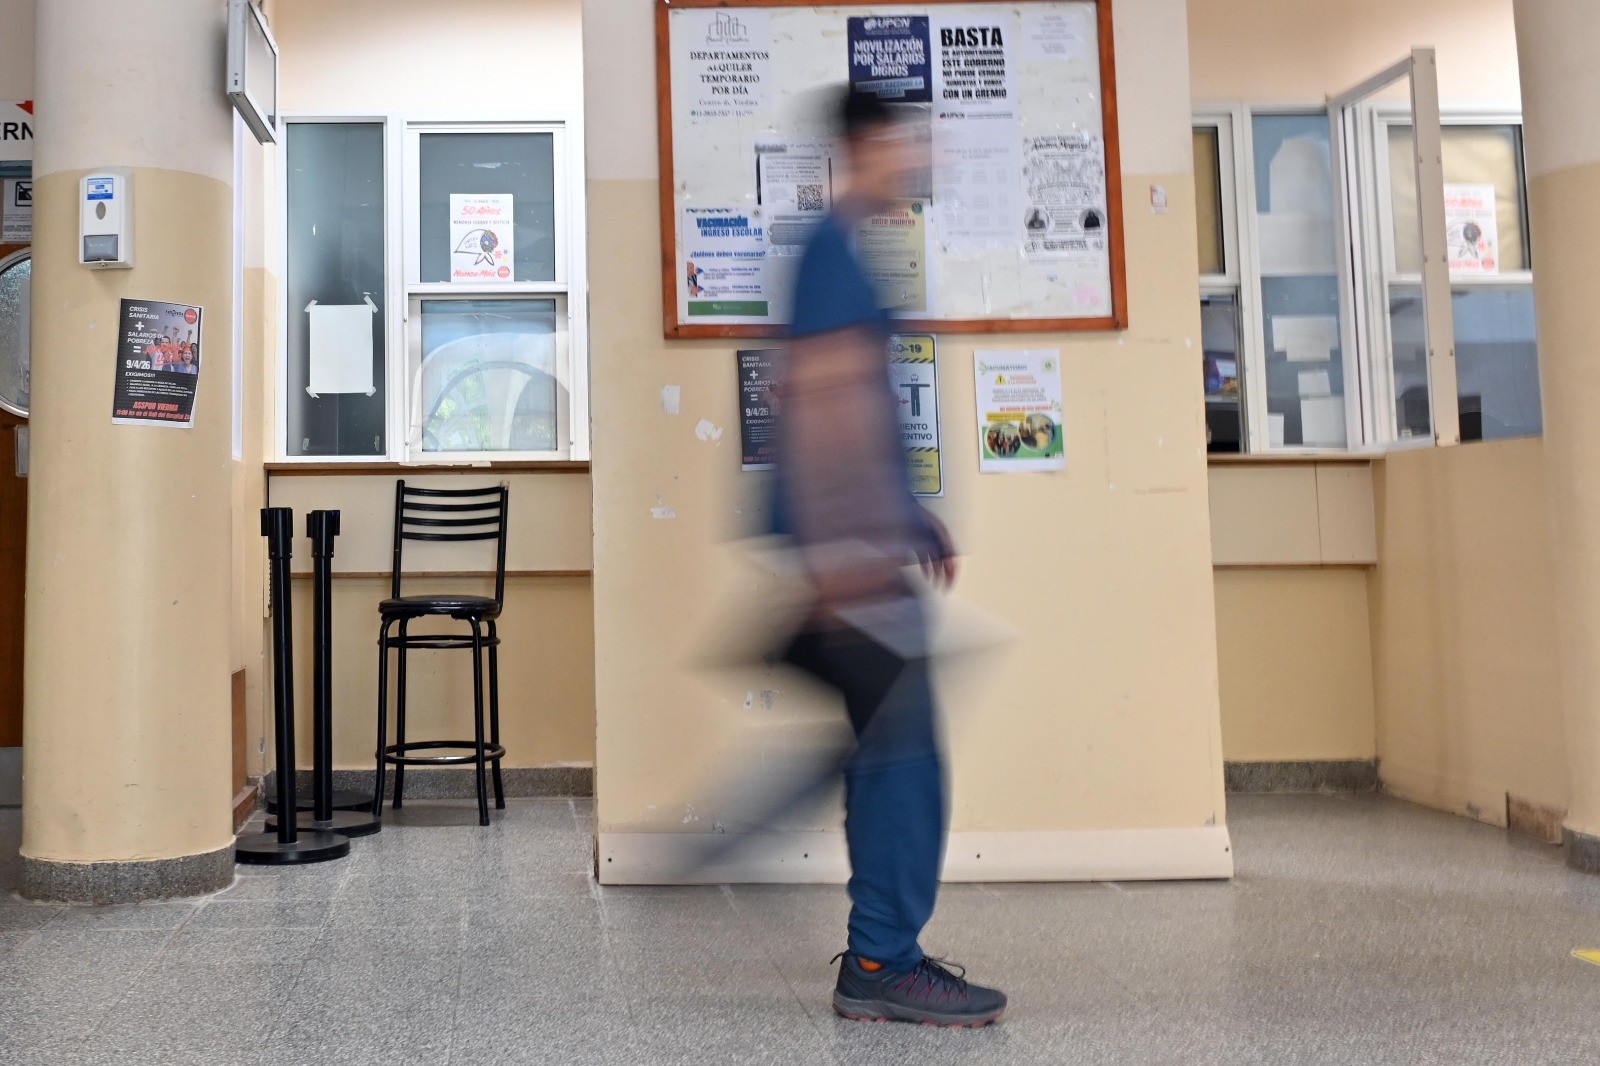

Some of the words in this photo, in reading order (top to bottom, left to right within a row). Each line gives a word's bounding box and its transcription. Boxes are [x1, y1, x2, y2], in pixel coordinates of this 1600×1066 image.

[940, 26, 1003, 47] BASTA
[854, 35, 924, 53] MOVILIZACIÓN
[689, 51, 770, 60] DEPARTAMENTOS
[853, 52, 875, 66] POR
[876, 51, 926, 66] SALARIOS
[707, 62, 753, 72] ALQUILER
[942, 58, 961, 67] ESTE
[963, 58, 1005, 67] GOBIERNO
[871, 64, 909, 77] DIGNOS
[942, 69, 953, 77] NO
[699, 74, 760, 83] TEMPORARIO
[711, 86, 730, 95] POR
[732, 85, 749, 95] DÍA
[942, 88, 960, 99] CON
[961, 88, 973, 99] UN
[975, 88, 1007, 99] GREMIO
[696, 216, 749, 228] VACUNACIÓN
[889, 217, 916, 227] mujeres
[700, 228, 730, 237] INGRESO
[732, 227, 763, 237] ESCOLAR
[716, 250, 733, 258] deben
[128, 312, 159, 320] SANITARIA
[127, 331, 157, 339] SALARIOS
[127, 337, 155, 346] POBREZA
[126, 359, 151, 370] 9/4/26
[745, 407, 769, 417] 9/4/26
